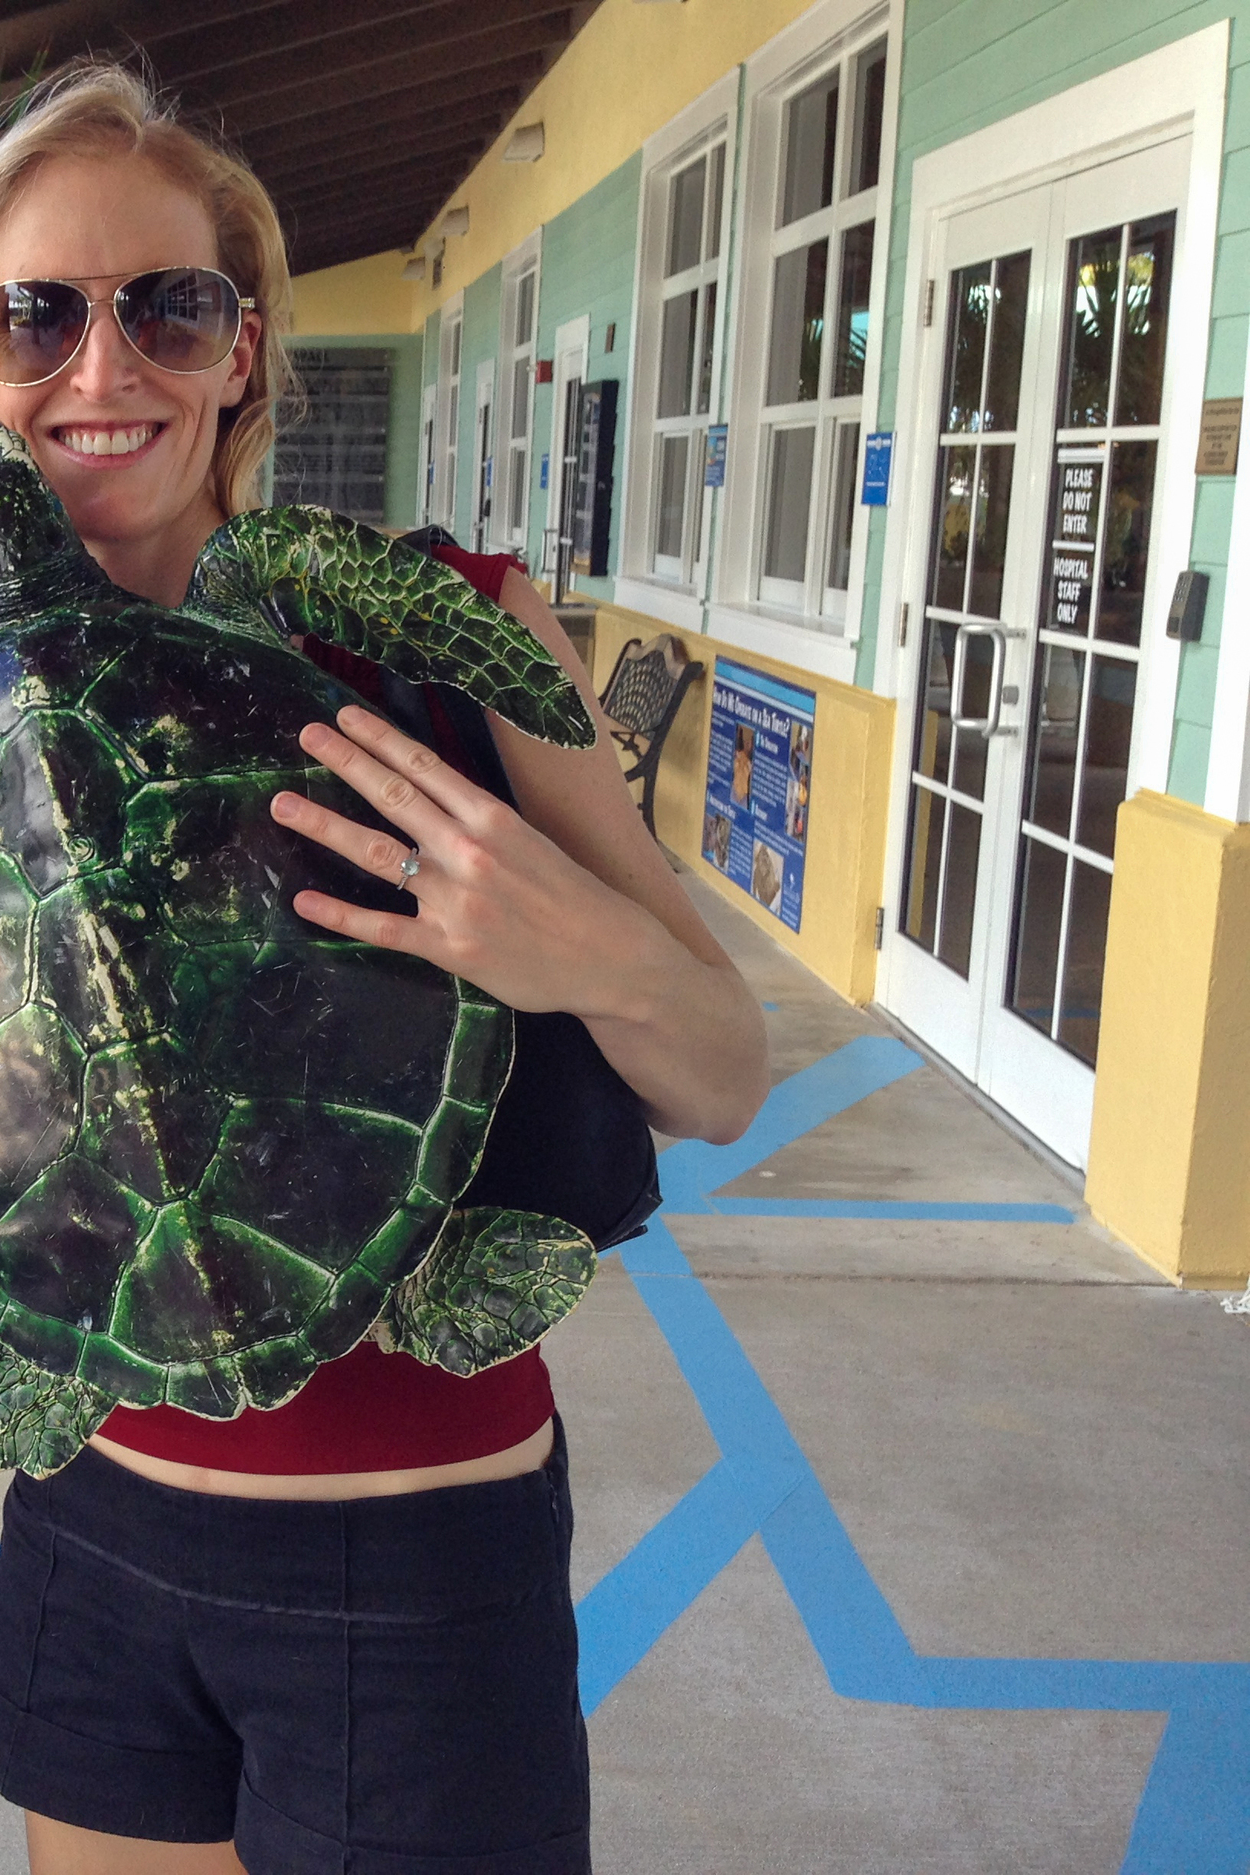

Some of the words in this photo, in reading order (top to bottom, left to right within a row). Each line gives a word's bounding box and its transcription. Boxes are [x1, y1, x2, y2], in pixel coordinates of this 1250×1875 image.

[1065, 468, 1093, 488] PLEASE
[1063, 491, 1074, 511] DO
[1075, 491, 1092, 512] NOT
[1063, 514, 1087, 534] ENTER
[1053, 556, 1088, 580] HOSPITAL
[1058, 579, 1081, 602] STAFF
[1057, 601, 1078, 624] ONLY
